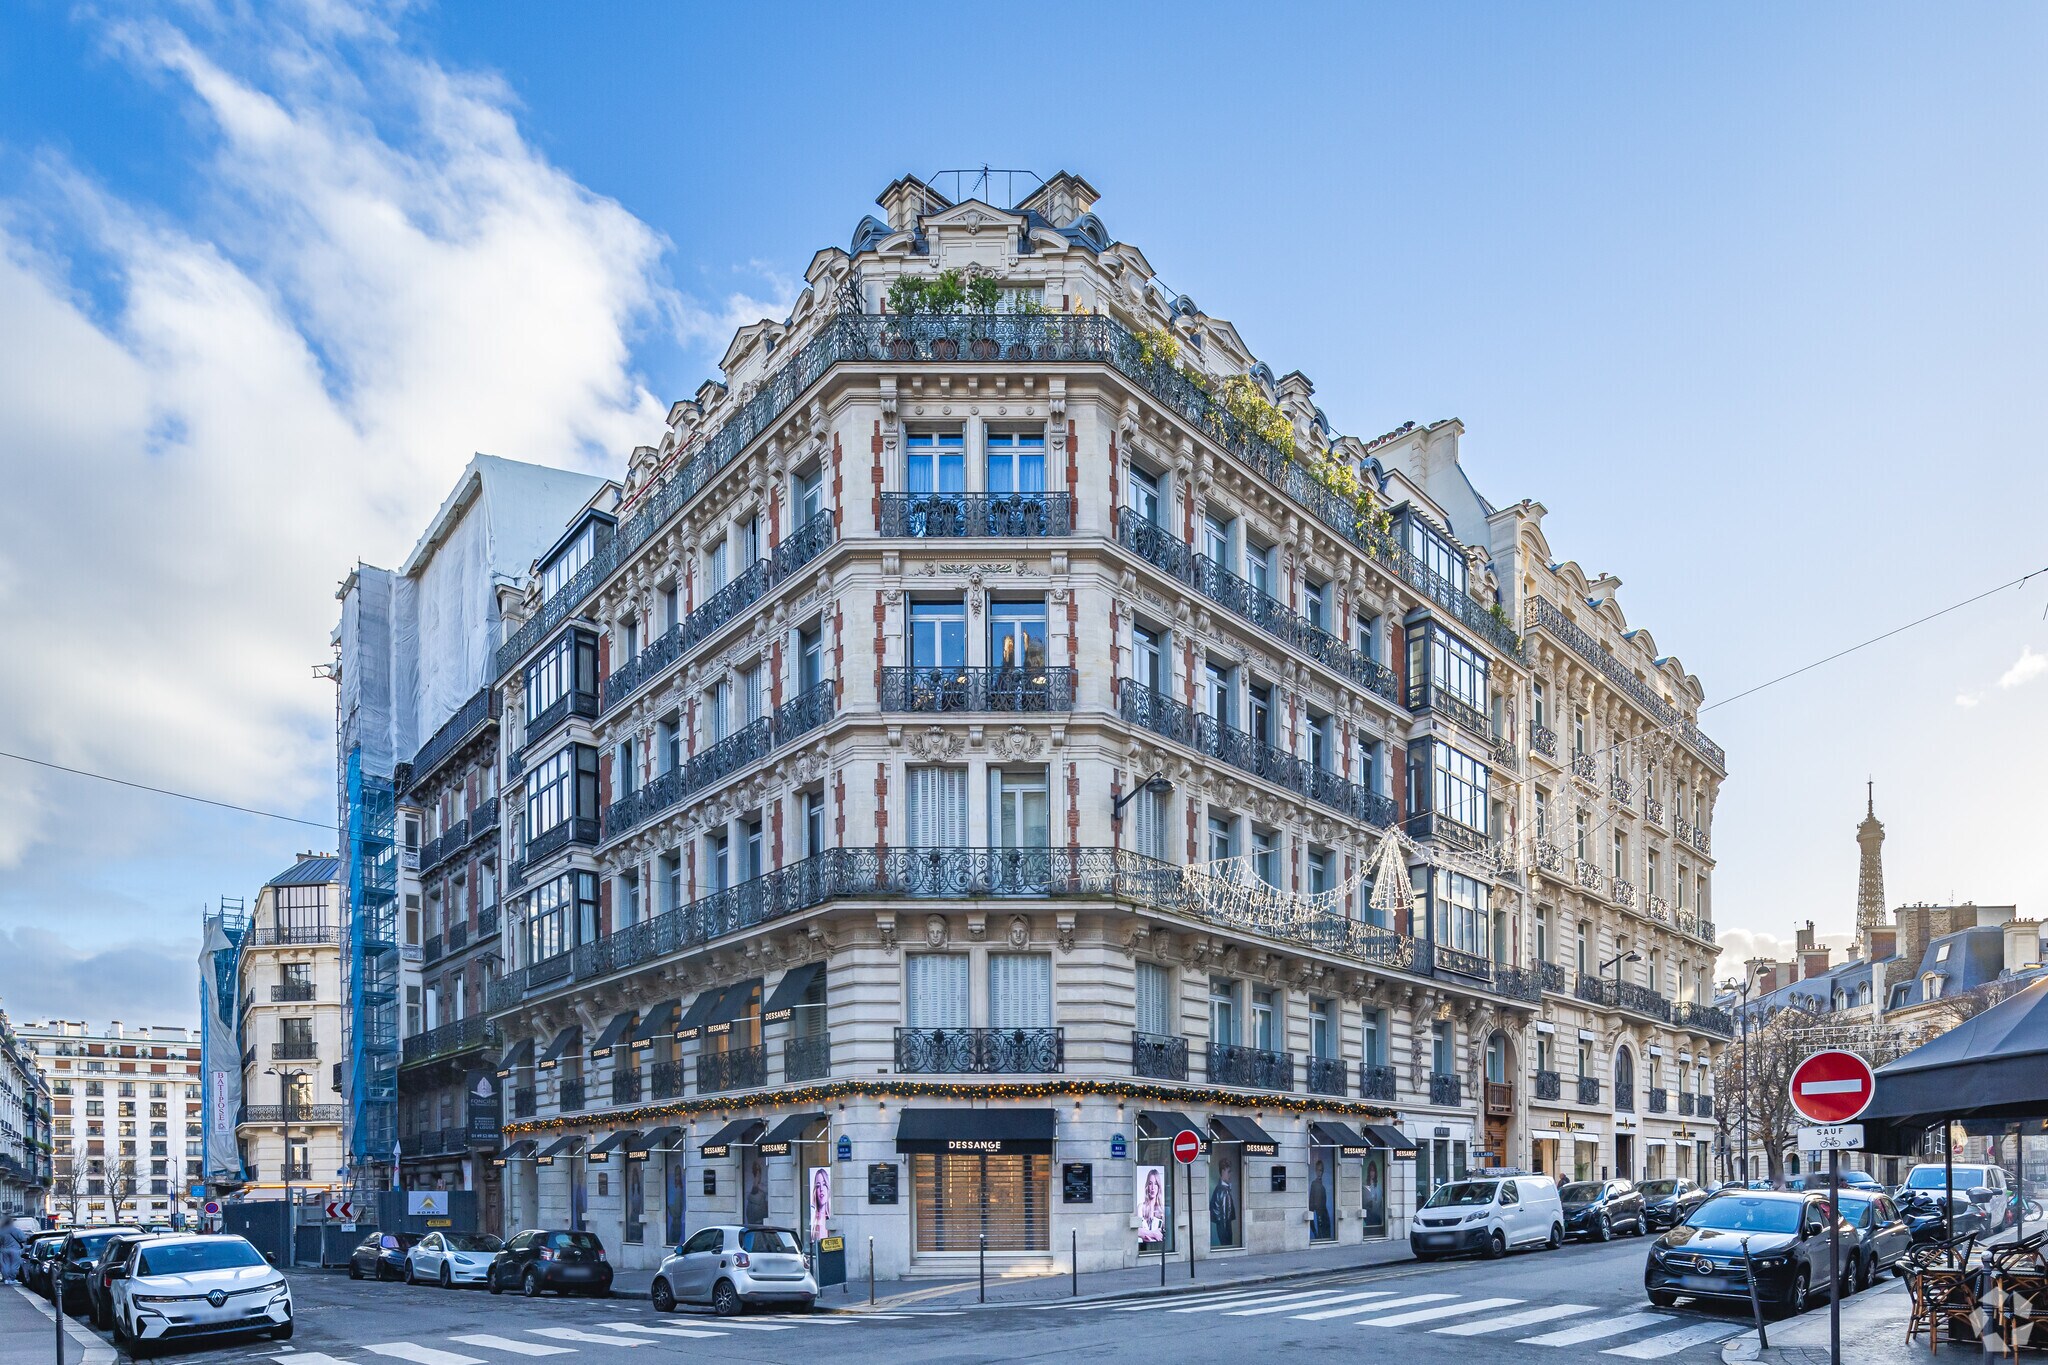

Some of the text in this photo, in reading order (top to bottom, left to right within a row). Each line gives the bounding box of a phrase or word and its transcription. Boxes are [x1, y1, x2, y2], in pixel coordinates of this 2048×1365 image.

[765, 1008, 791, 1021] DESSANGE
[707, 1022, 730, 1033] DESSANGE
[677, 1028, 698, 1039] DESSANGE
[632, 1038, 650, 1048] DESSANGE
[1816, 1127, 1843, 1136] SAUF
[761, 1143, 787, 1152] DESSANGE
[948, 1141, 1001, 1149] DESSANGE
[1246, 1144, 1275, 1152] DESSANGE
[629, 1150, 647, 1159] DESSANGE
[704, 1146, 726, 1154] DESSANGE
